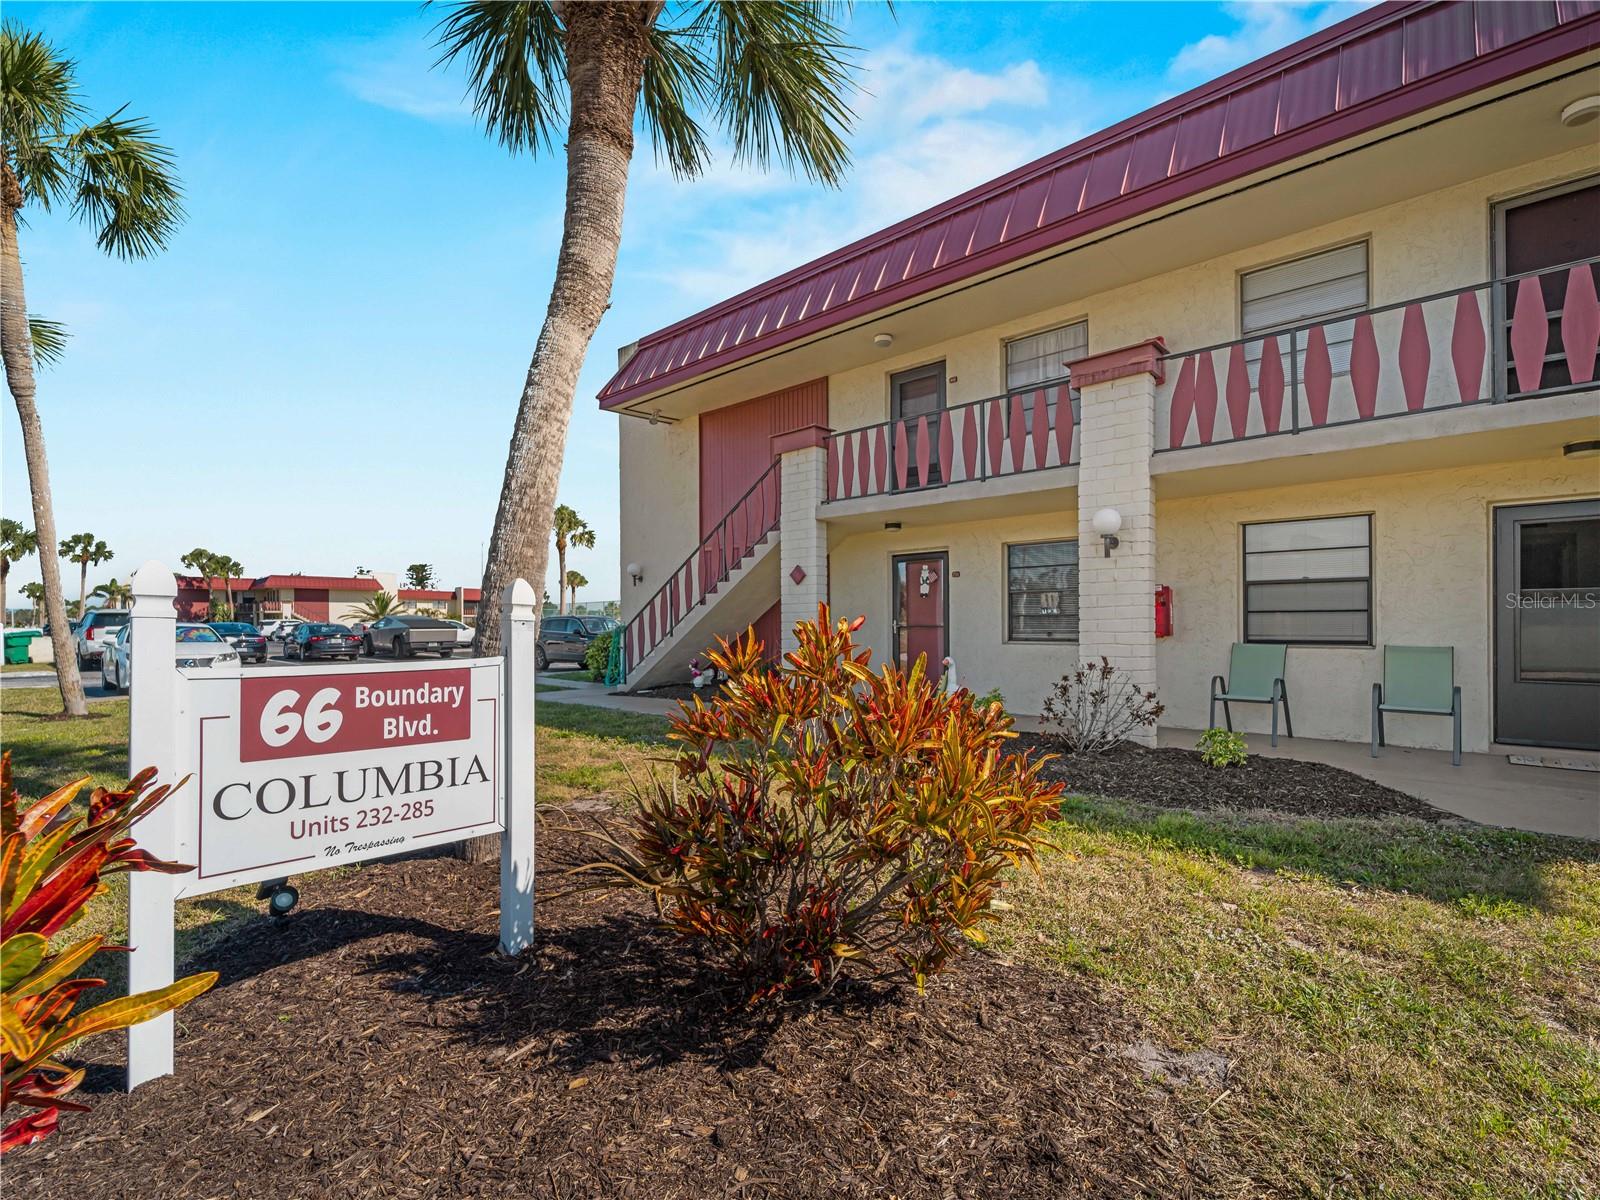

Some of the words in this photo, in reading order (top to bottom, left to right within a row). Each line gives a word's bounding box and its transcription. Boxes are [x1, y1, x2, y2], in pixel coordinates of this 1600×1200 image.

[259, 687, 344, 747] 66
[355, 682, 465, 708] Boundary
[383, 714, 439, 740] Blvd.
[212, 754, 491, 821] COLUMBIA
[290, 815, 350, 840] Units
[356, 799, 435, 829] 232-285
[324, 845, 341, 857] No
[345, 835, 406, 854] Trespassing
